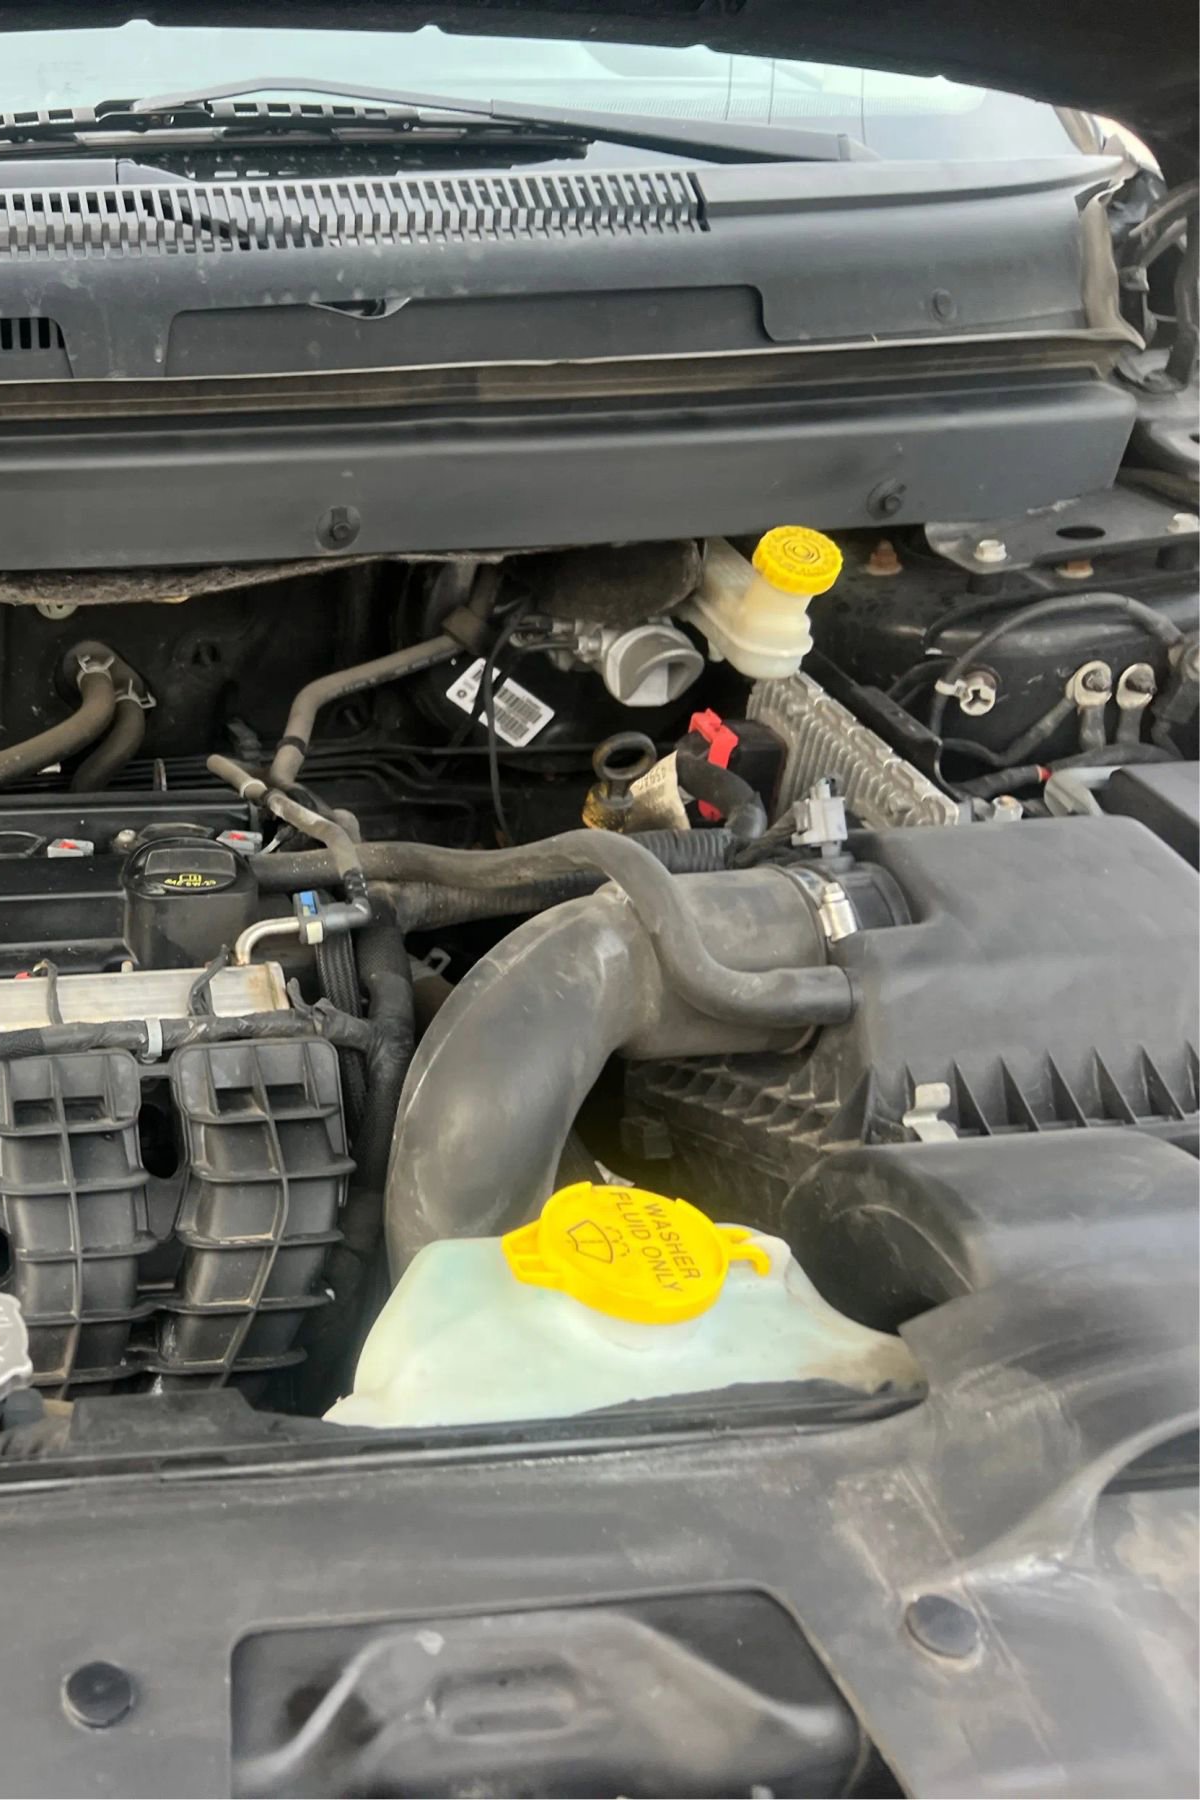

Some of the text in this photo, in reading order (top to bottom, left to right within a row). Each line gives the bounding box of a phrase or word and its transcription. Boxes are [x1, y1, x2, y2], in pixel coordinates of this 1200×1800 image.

[611, 1192, 682, 1293] FLUID ONLY
[644, 1203, 701, 1280] WASHER
